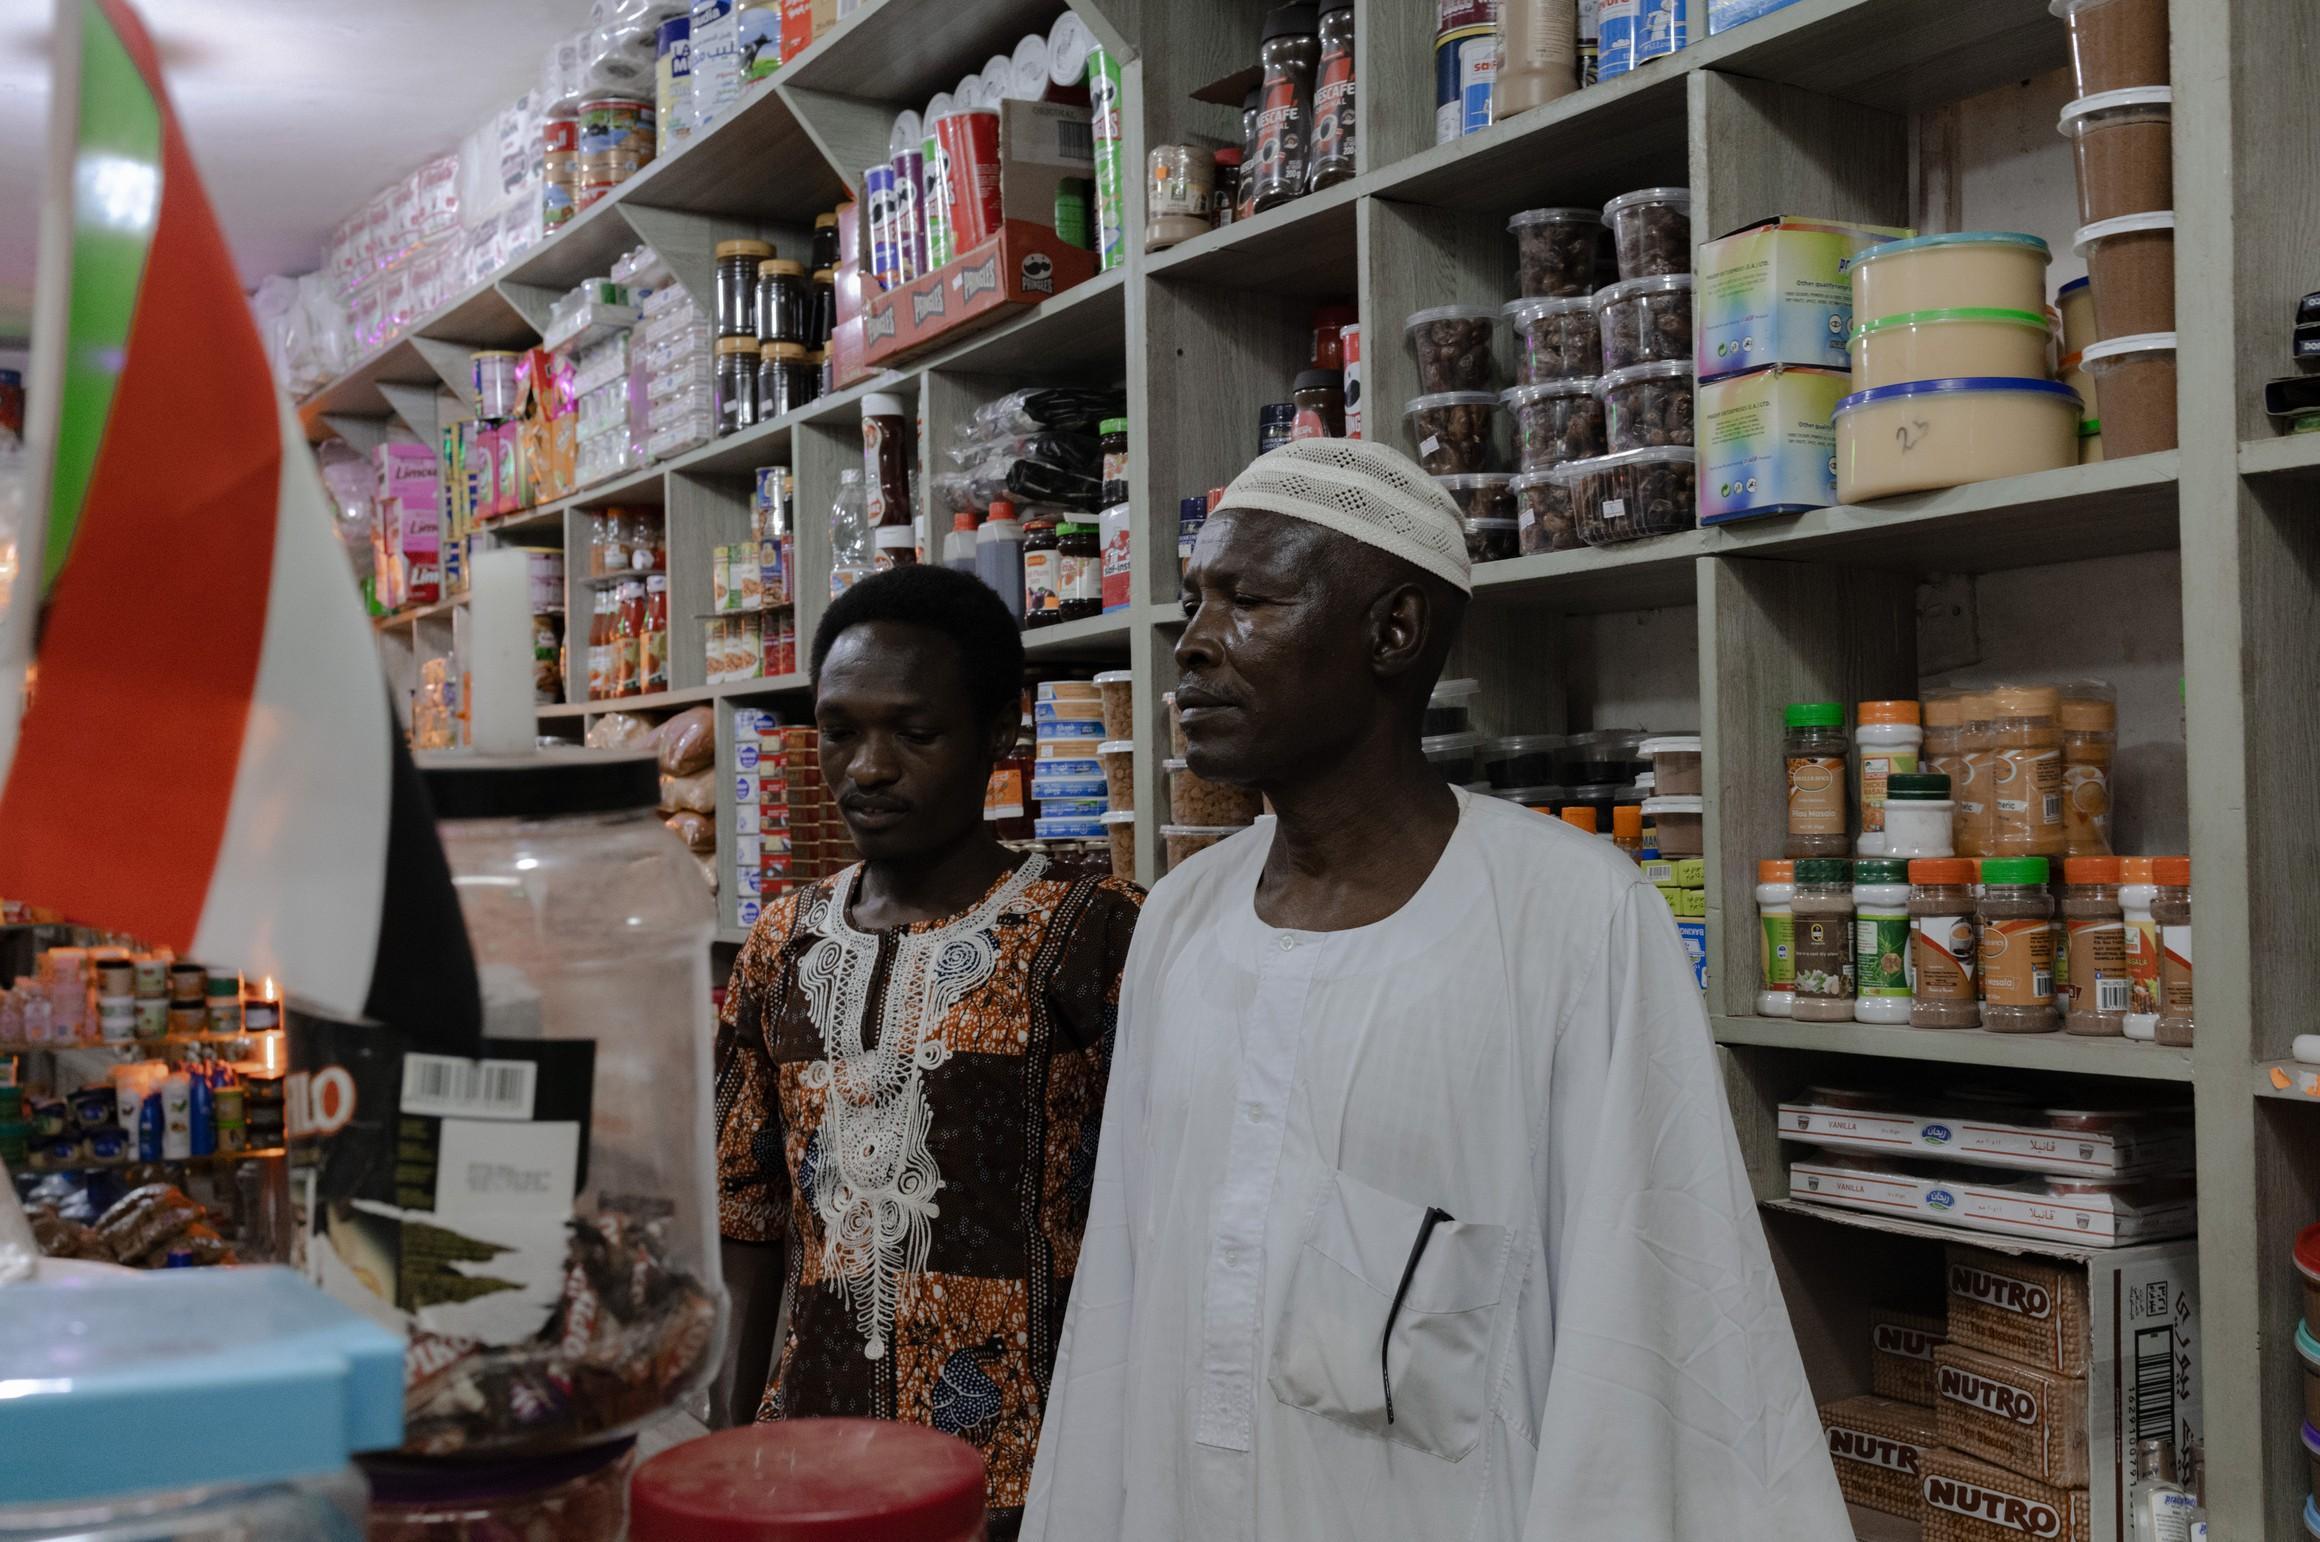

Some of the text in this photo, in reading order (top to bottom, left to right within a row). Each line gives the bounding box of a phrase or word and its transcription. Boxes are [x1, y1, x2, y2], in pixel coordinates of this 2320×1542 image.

[1828, 1120, 1857, 1131] VANILLA
[1836, 1182, 1865, 1193] VANILLA
[1952, 1267, 2048, 1315] NUTRO
[1878, 1326, 1947, 1354] NUT
[1941, 1370, 2035, 1420] NUTRO
[1829, 1430, 1920, 1475] NUTR
[1929, 1479, 2056, 1533] NUTRO
